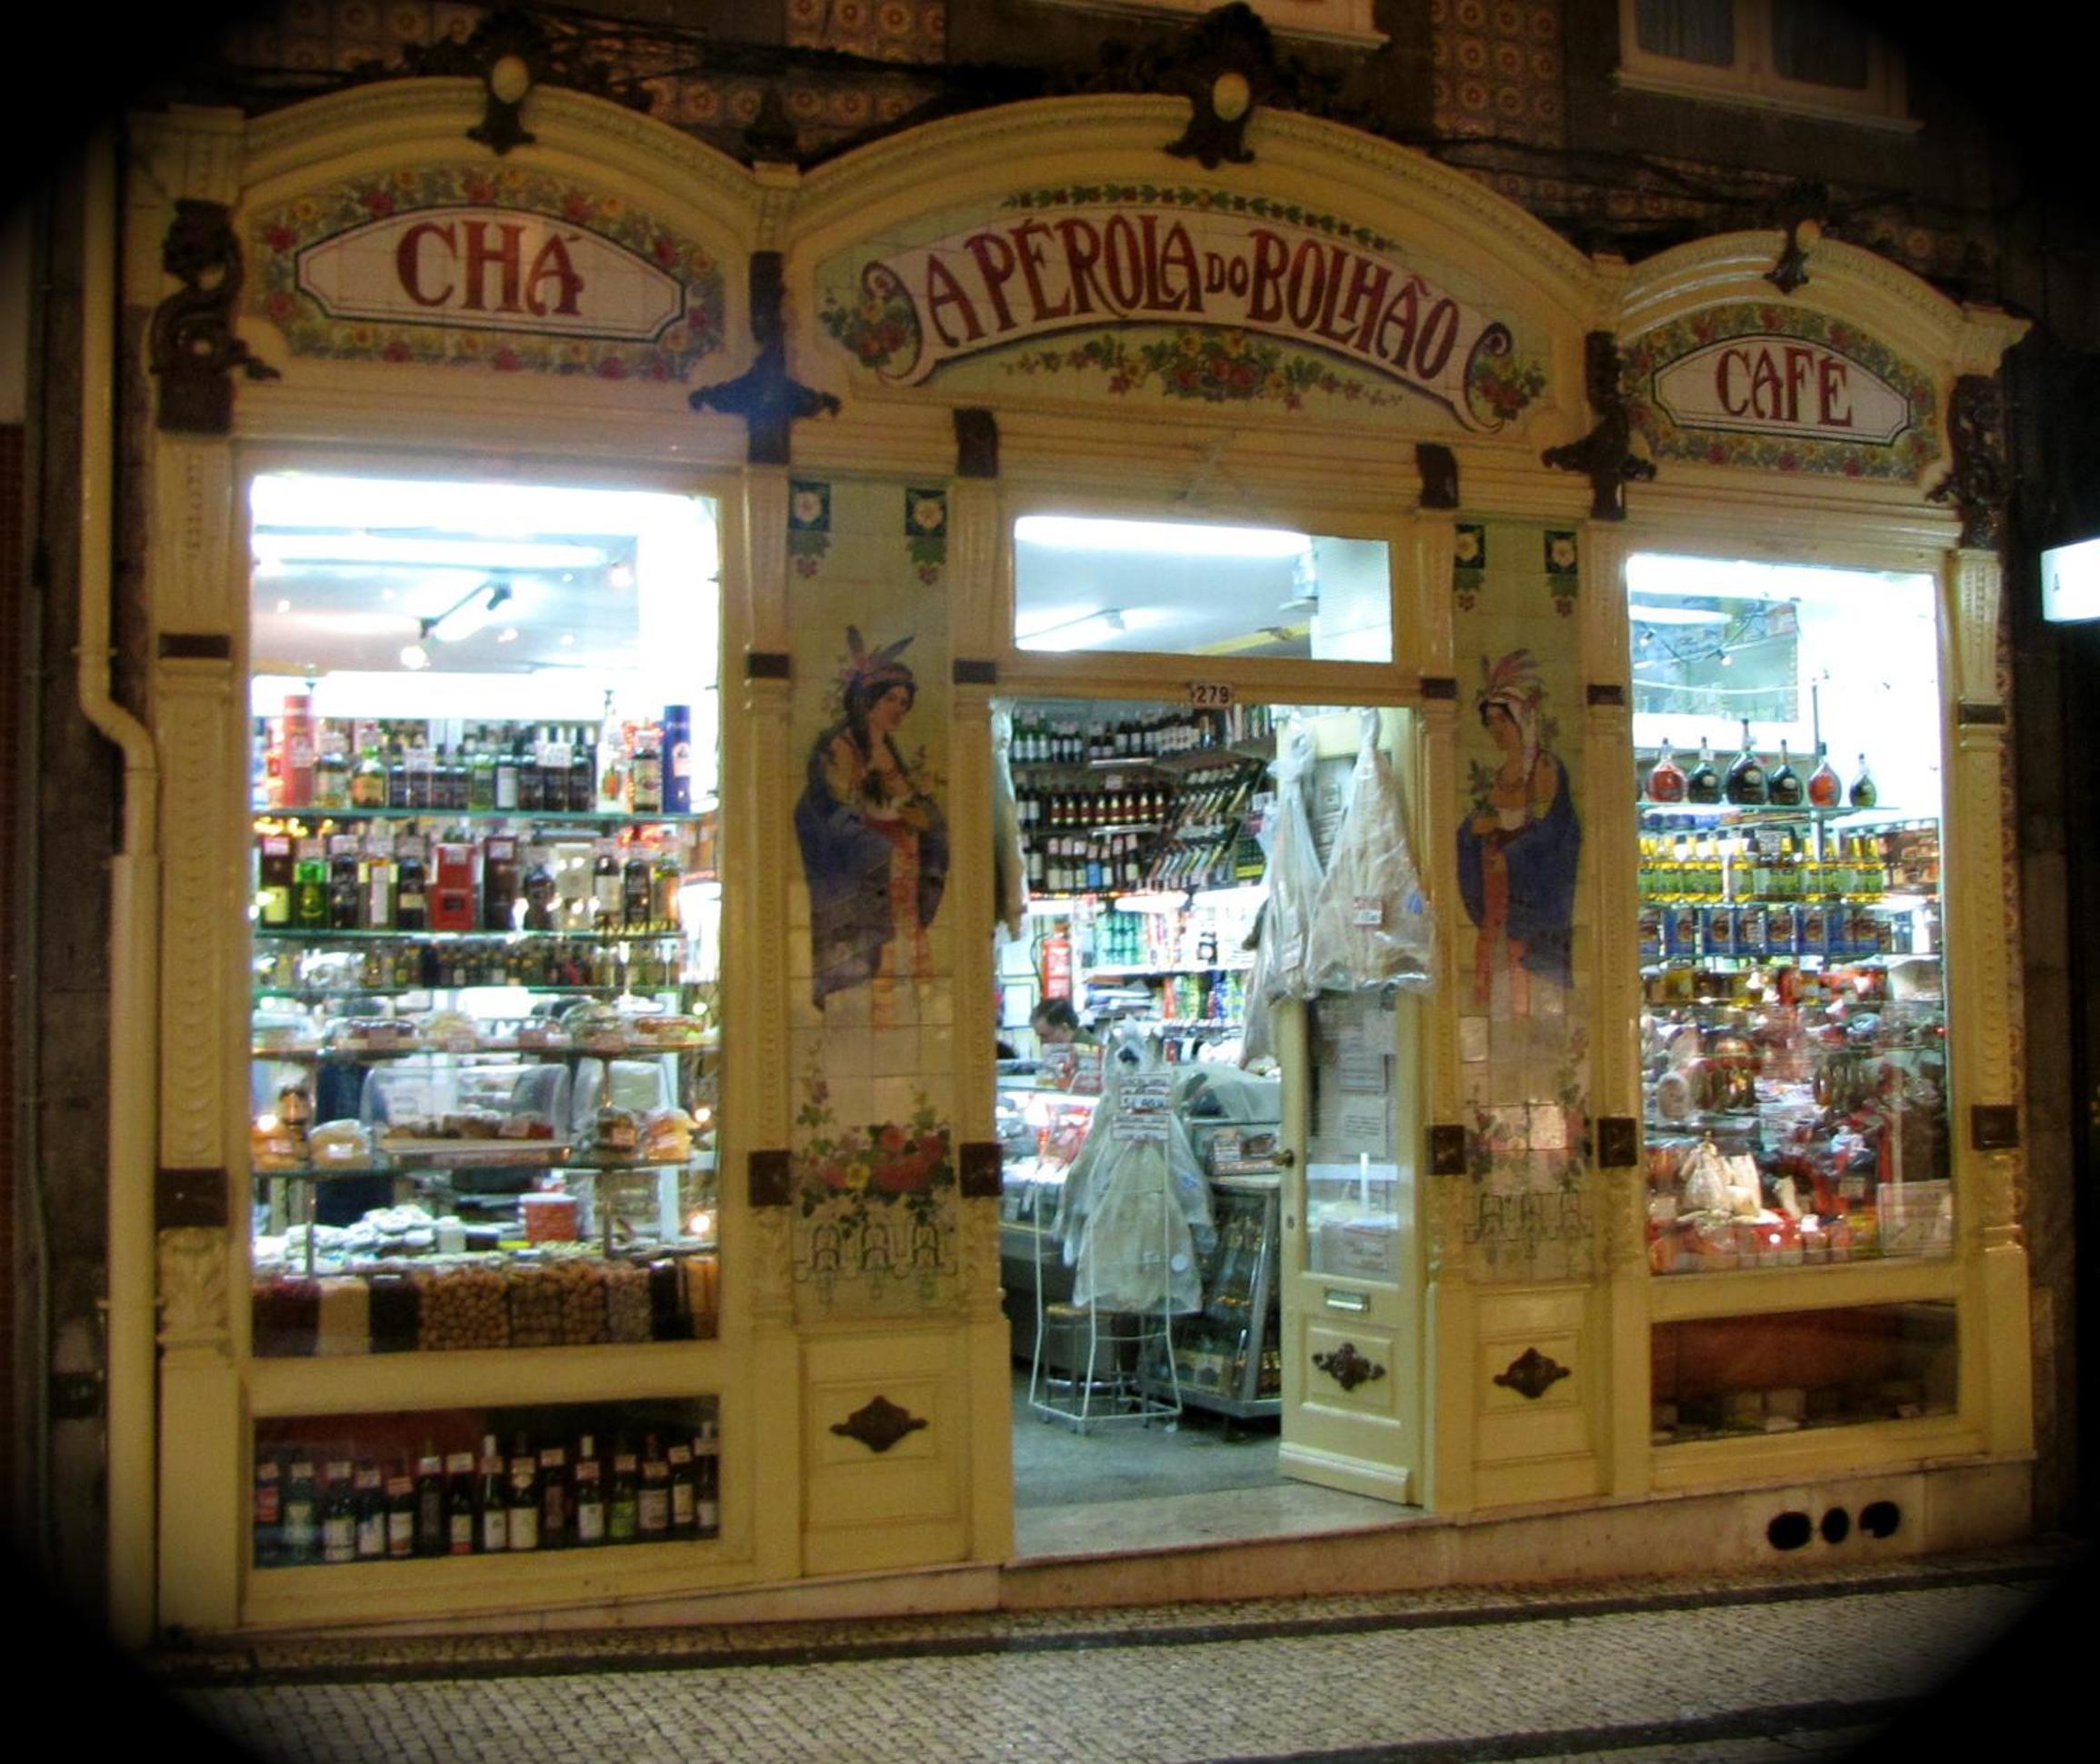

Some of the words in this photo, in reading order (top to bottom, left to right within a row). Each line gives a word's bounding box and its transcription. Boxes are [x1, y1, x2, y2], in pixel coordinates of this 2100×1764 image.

[396, 220, 584, 316] CHÁ
[925, 253, 984, 348] A
[963, 213, 1205, 332] PÉROLA
[1245, 228, 1461, 380] BOLHÃO
[1716, 346, 1853, 426] CAFÉ
